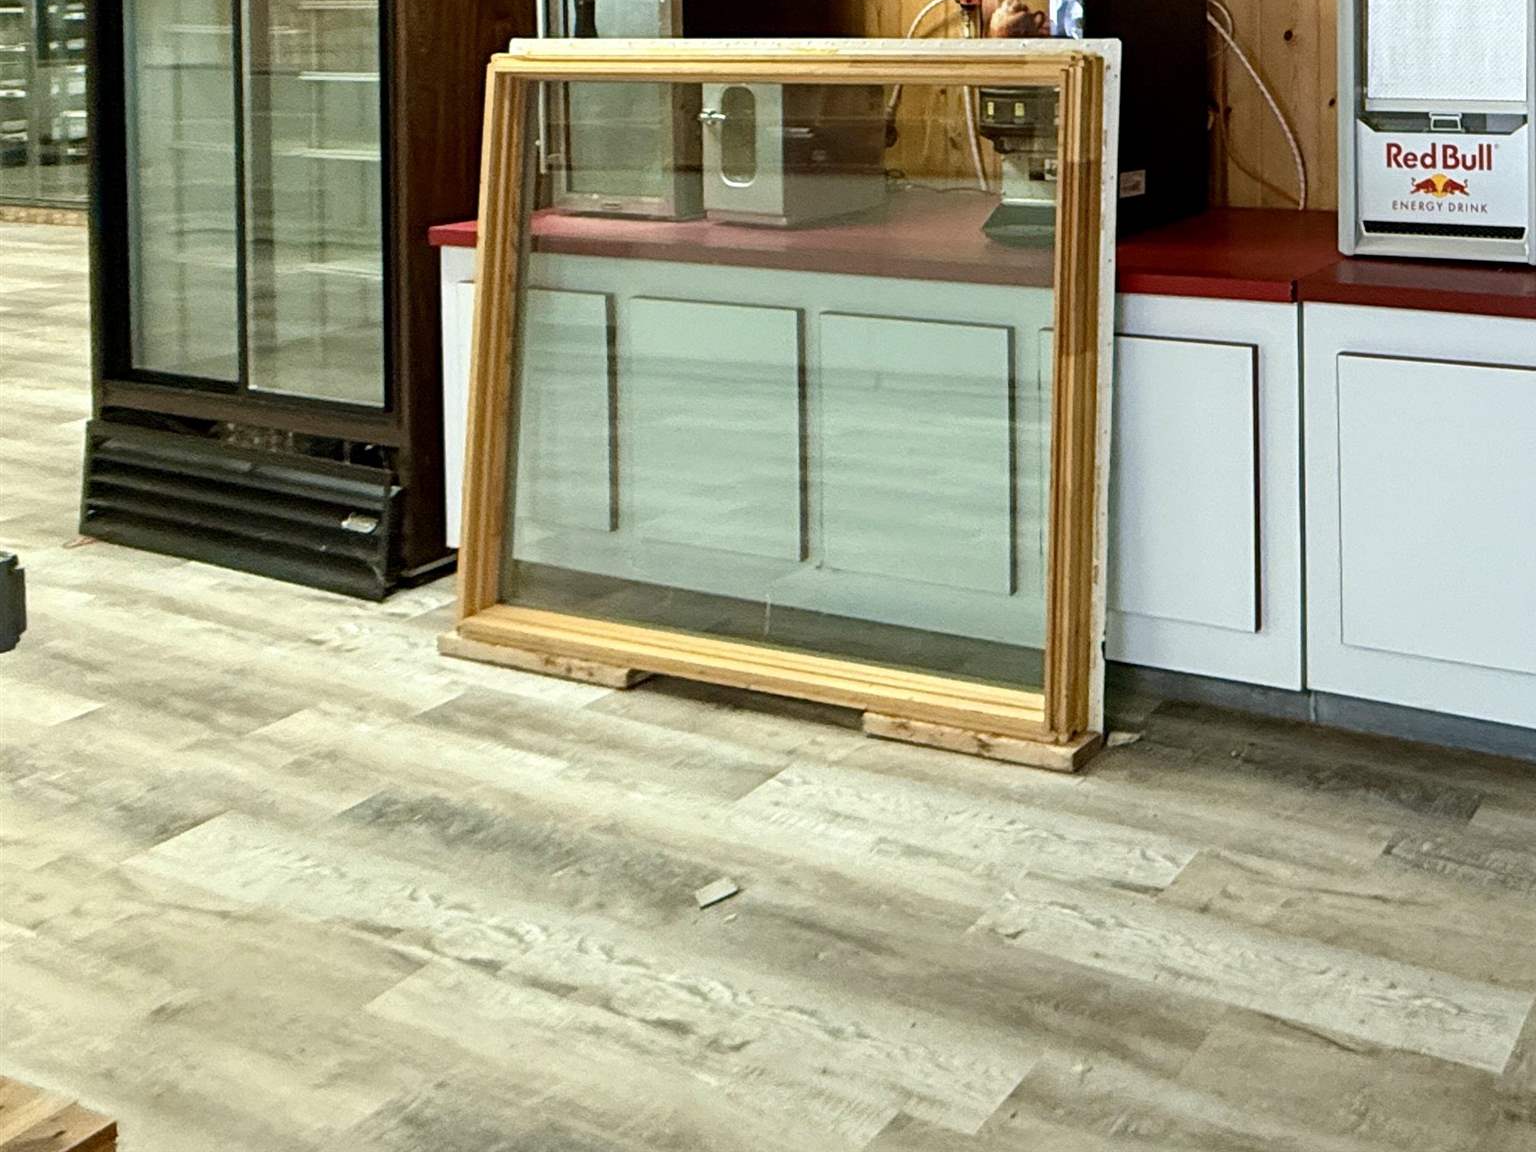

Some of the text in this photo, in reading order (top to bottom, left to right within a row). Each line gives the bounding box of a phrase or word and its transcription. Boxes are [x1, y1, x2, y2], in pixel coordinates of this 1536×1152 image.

[1386, 142, 1492, 171] Red Bull
[1392, 200, 1488, 213] ENERGY DRINK
